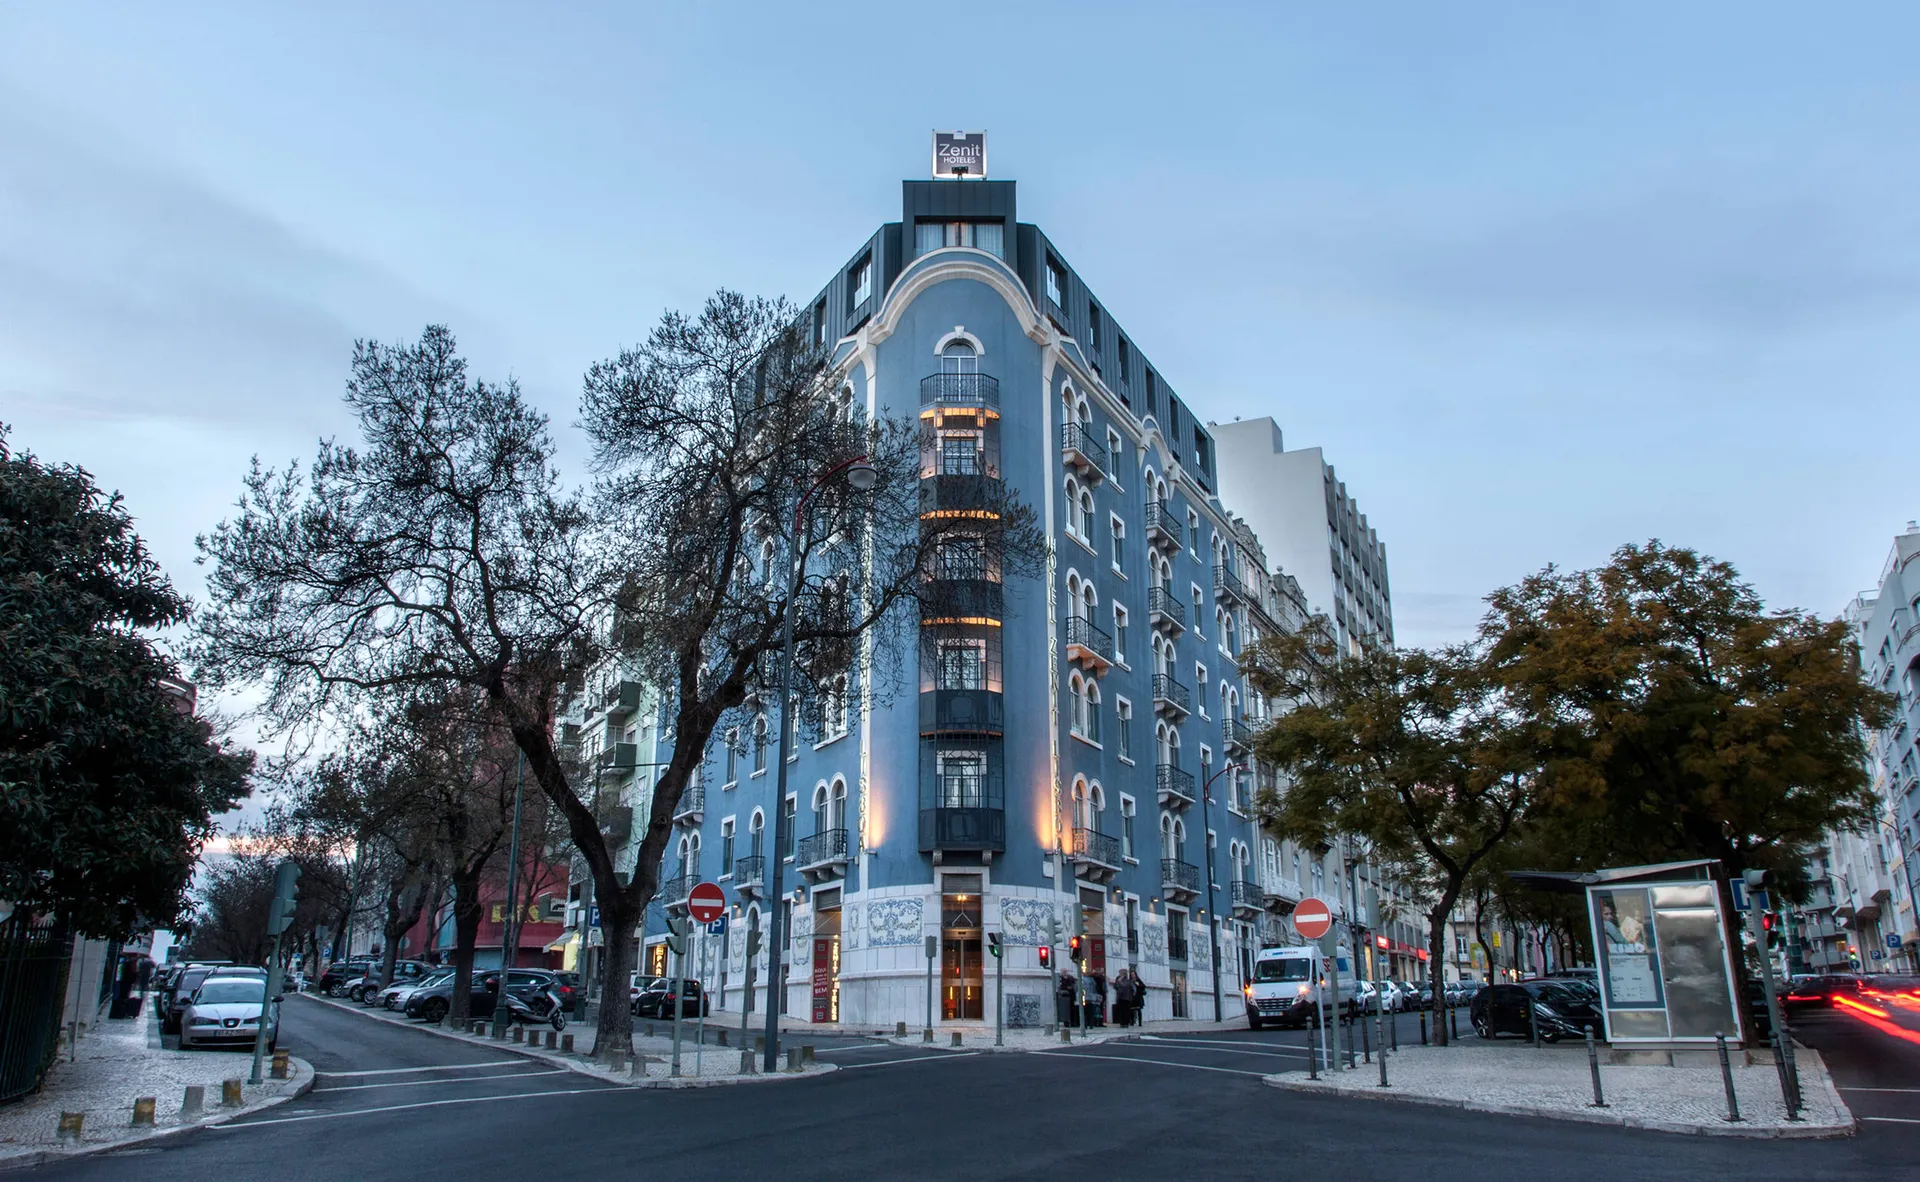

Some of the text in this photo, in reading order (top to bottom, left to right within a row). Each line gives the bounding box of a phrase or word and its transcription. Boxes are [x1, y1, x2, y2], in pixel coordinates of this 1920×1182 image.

[938, 143, 981, 157] Zenit
[943, 156, 976, 164] HOTELES
[1046, 535, 1057, 624] HOTEL
[1049, 636, 1060, 727] ZENIT
[858, 739, 867, 855] LISBOA
[711, 920, 722, 932] P
[1889, 936, 1898, 947] P
[831, 942, 839, 974] ZENIT
